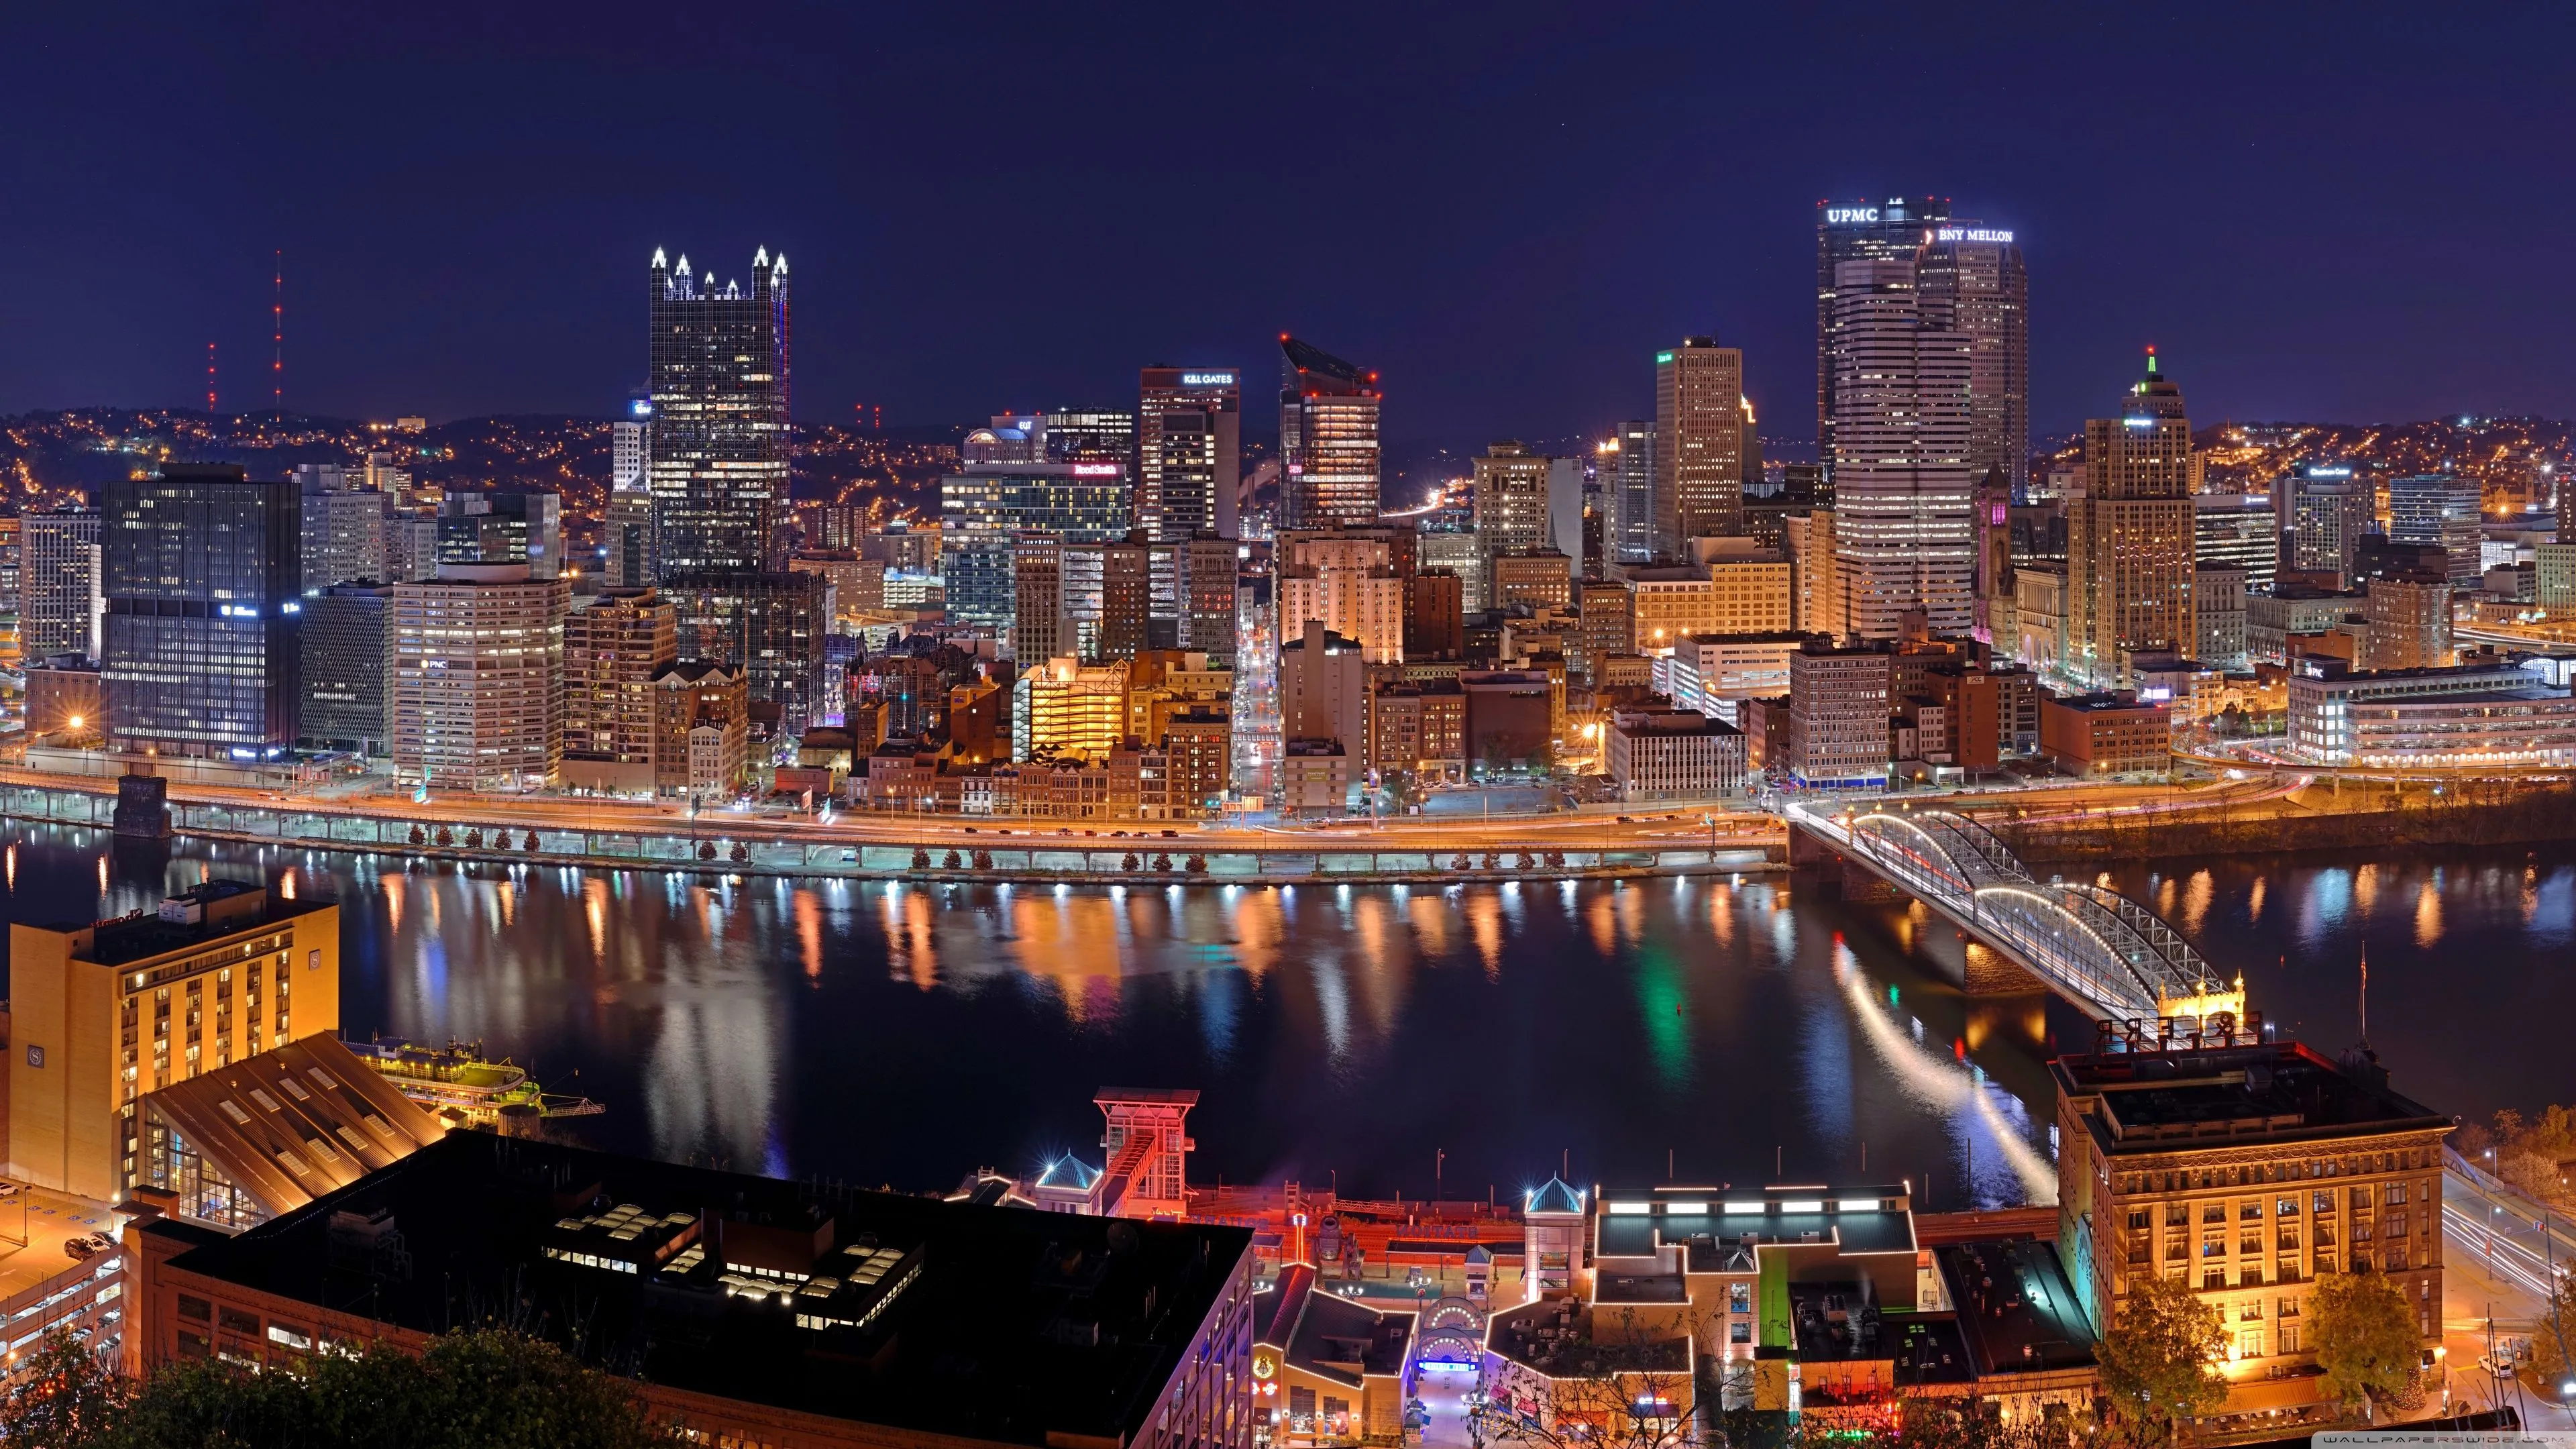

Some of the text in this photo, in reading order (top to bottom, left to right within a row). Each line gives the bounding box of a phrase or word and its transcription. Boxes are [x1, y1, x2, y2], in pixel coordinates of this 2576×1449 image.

[1827, 209, 1878, 222] UPMC
[1939, 230, 2012, 241] BNY MELLON
[1184, 375, 1232, 383] K&L GATES
[1075, 465, 1116, 474] Reed Smith
[2312, 667, 2323, 678] PNC
